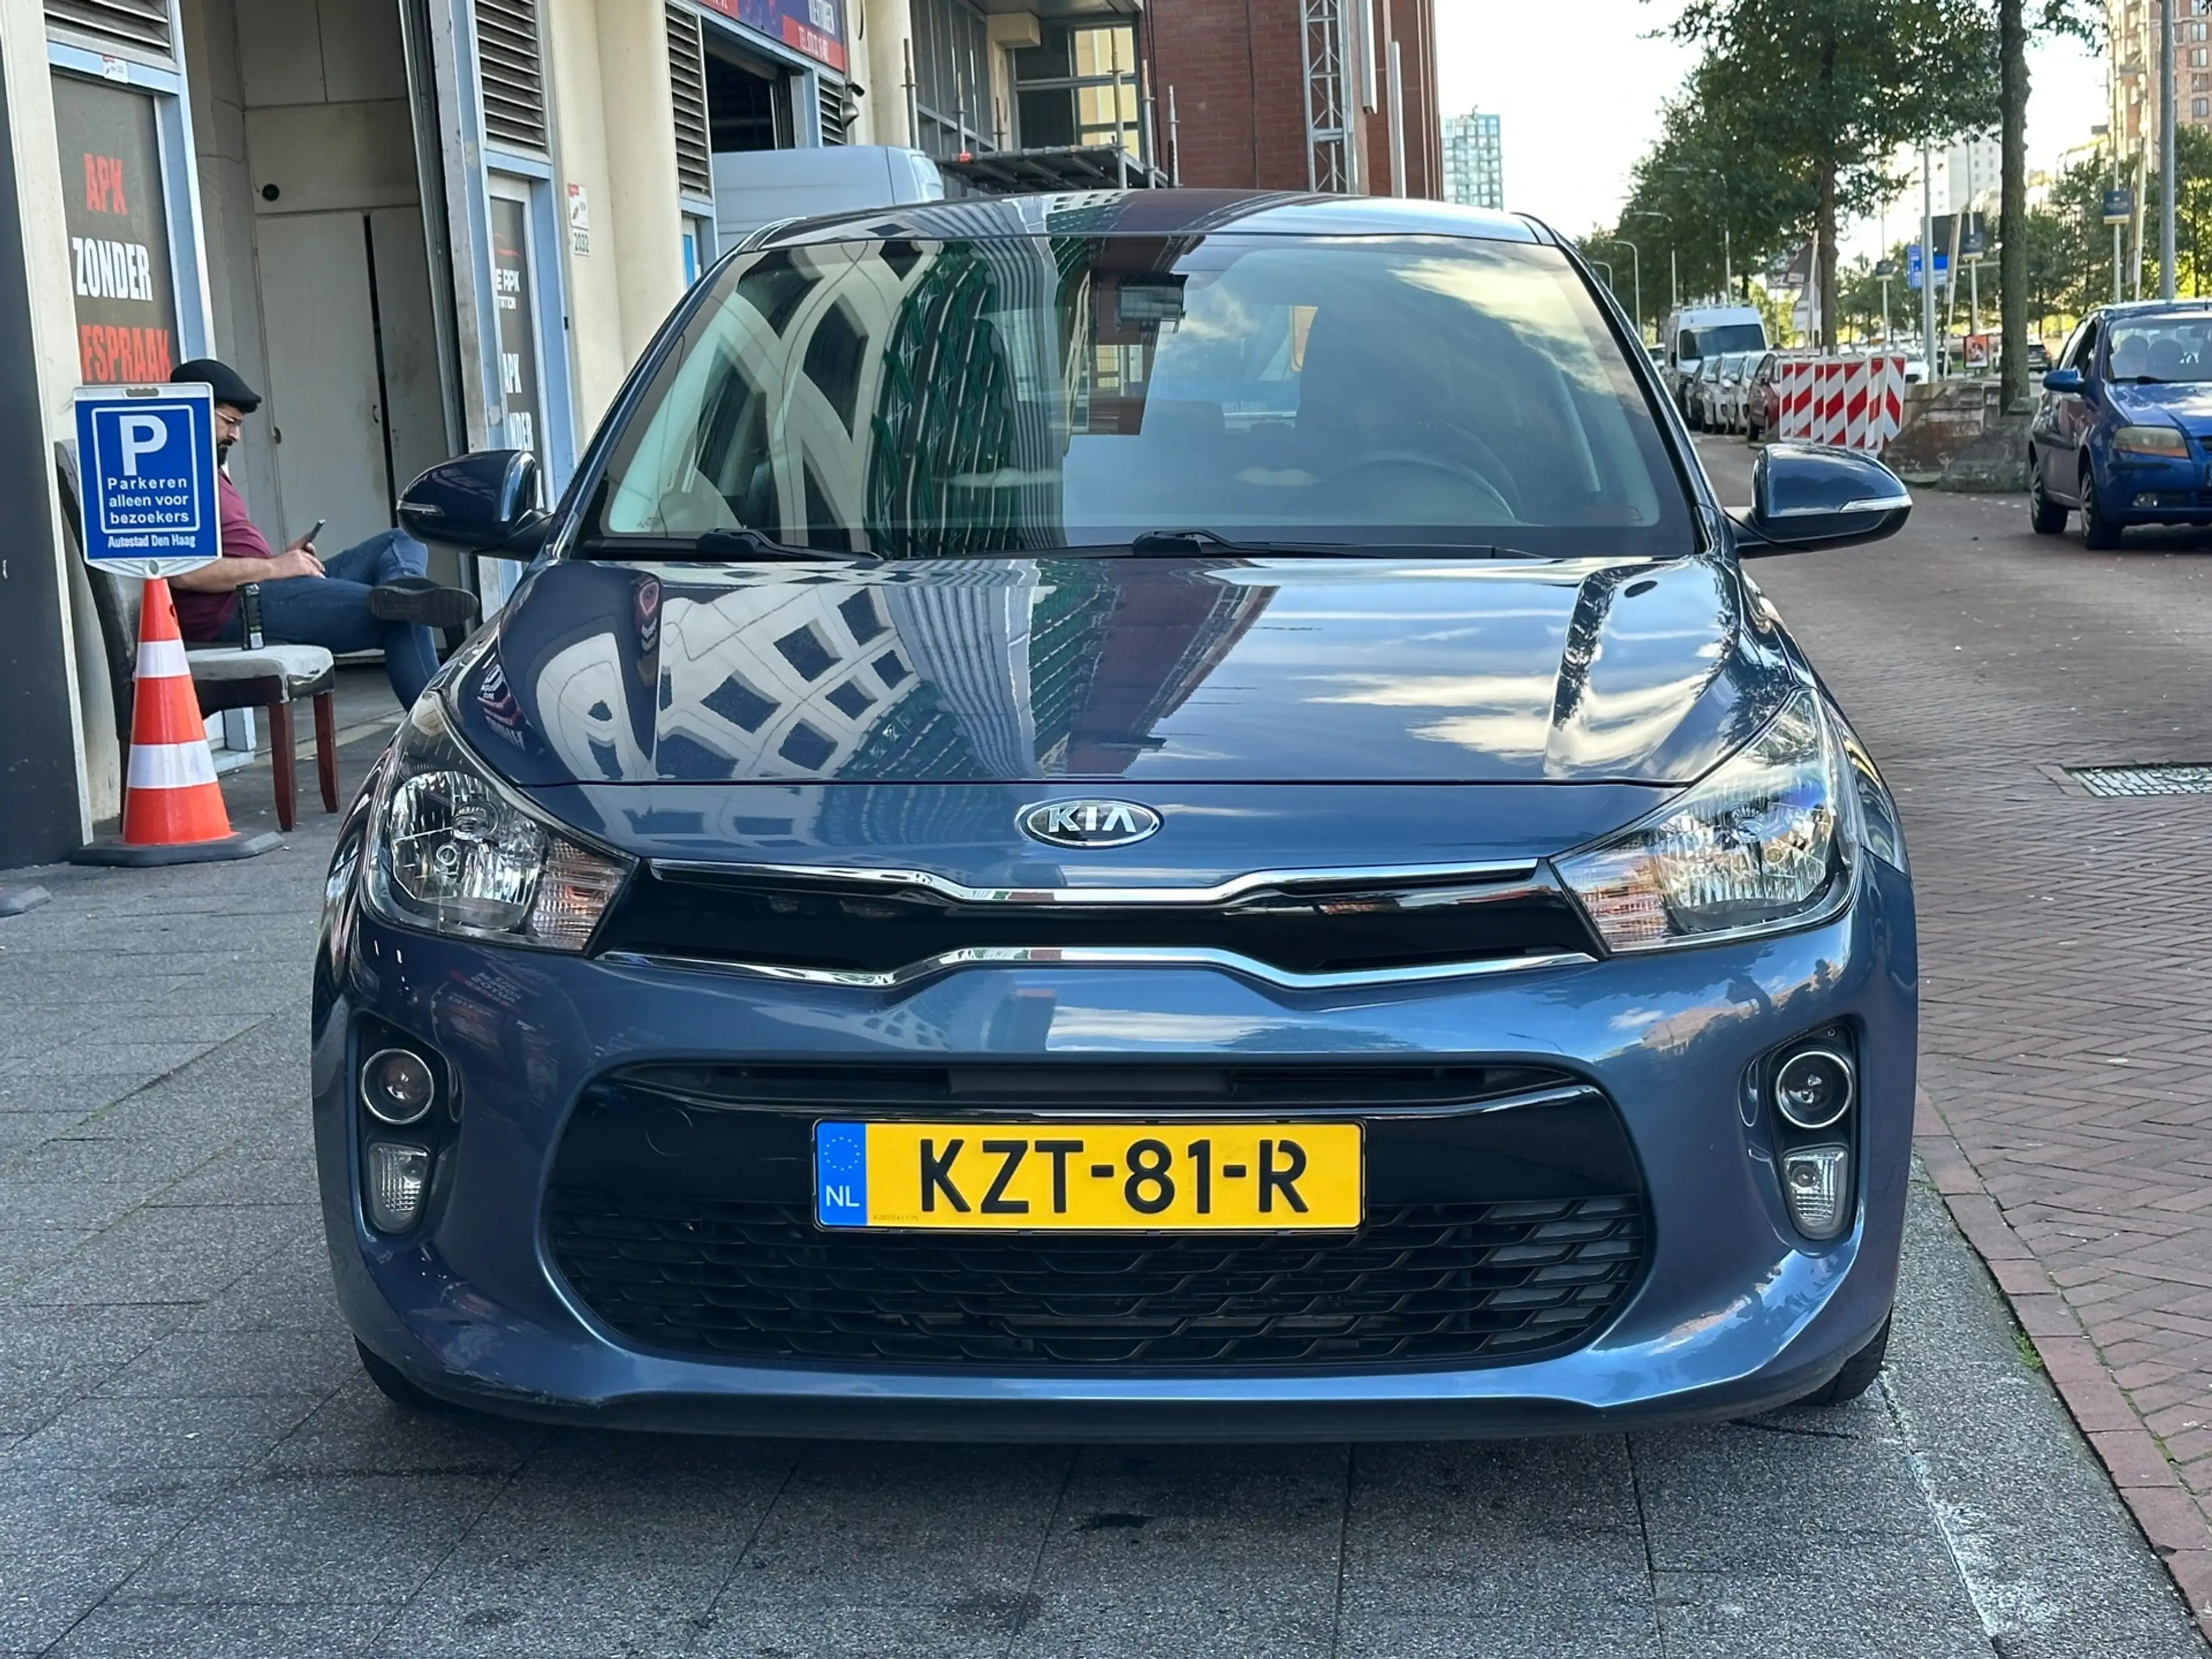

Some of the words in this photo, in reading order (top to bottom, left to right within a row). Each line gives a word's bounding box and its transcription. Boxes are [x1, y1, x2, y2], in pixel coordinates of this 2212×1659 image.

[84, 153, 127, 215] APK
[72, 237, 153, 301] ZONDER
[503, 269, 520, 292] APK
[78, 324, 172, 382] FSPRAAK
[119, 415, 168, 476] P
[509, 412, 534, 452] NDER
[107, 477, 187, 491] Parkeren
[109, 494, 151, 507] alleen
[155, 495, 189, 506] voor
[110, 510, 190, 524] bezoekers
[108, 535, 149, 548] Autostad
[151, 535, 169, 547] Den
[172, 534, 196, 548] Haag
[1048, 806, 1137, 833] KIA
[921, 1139, 1309, 1214] KZT-81-R
[825, 1185, 860, 1207] NL
